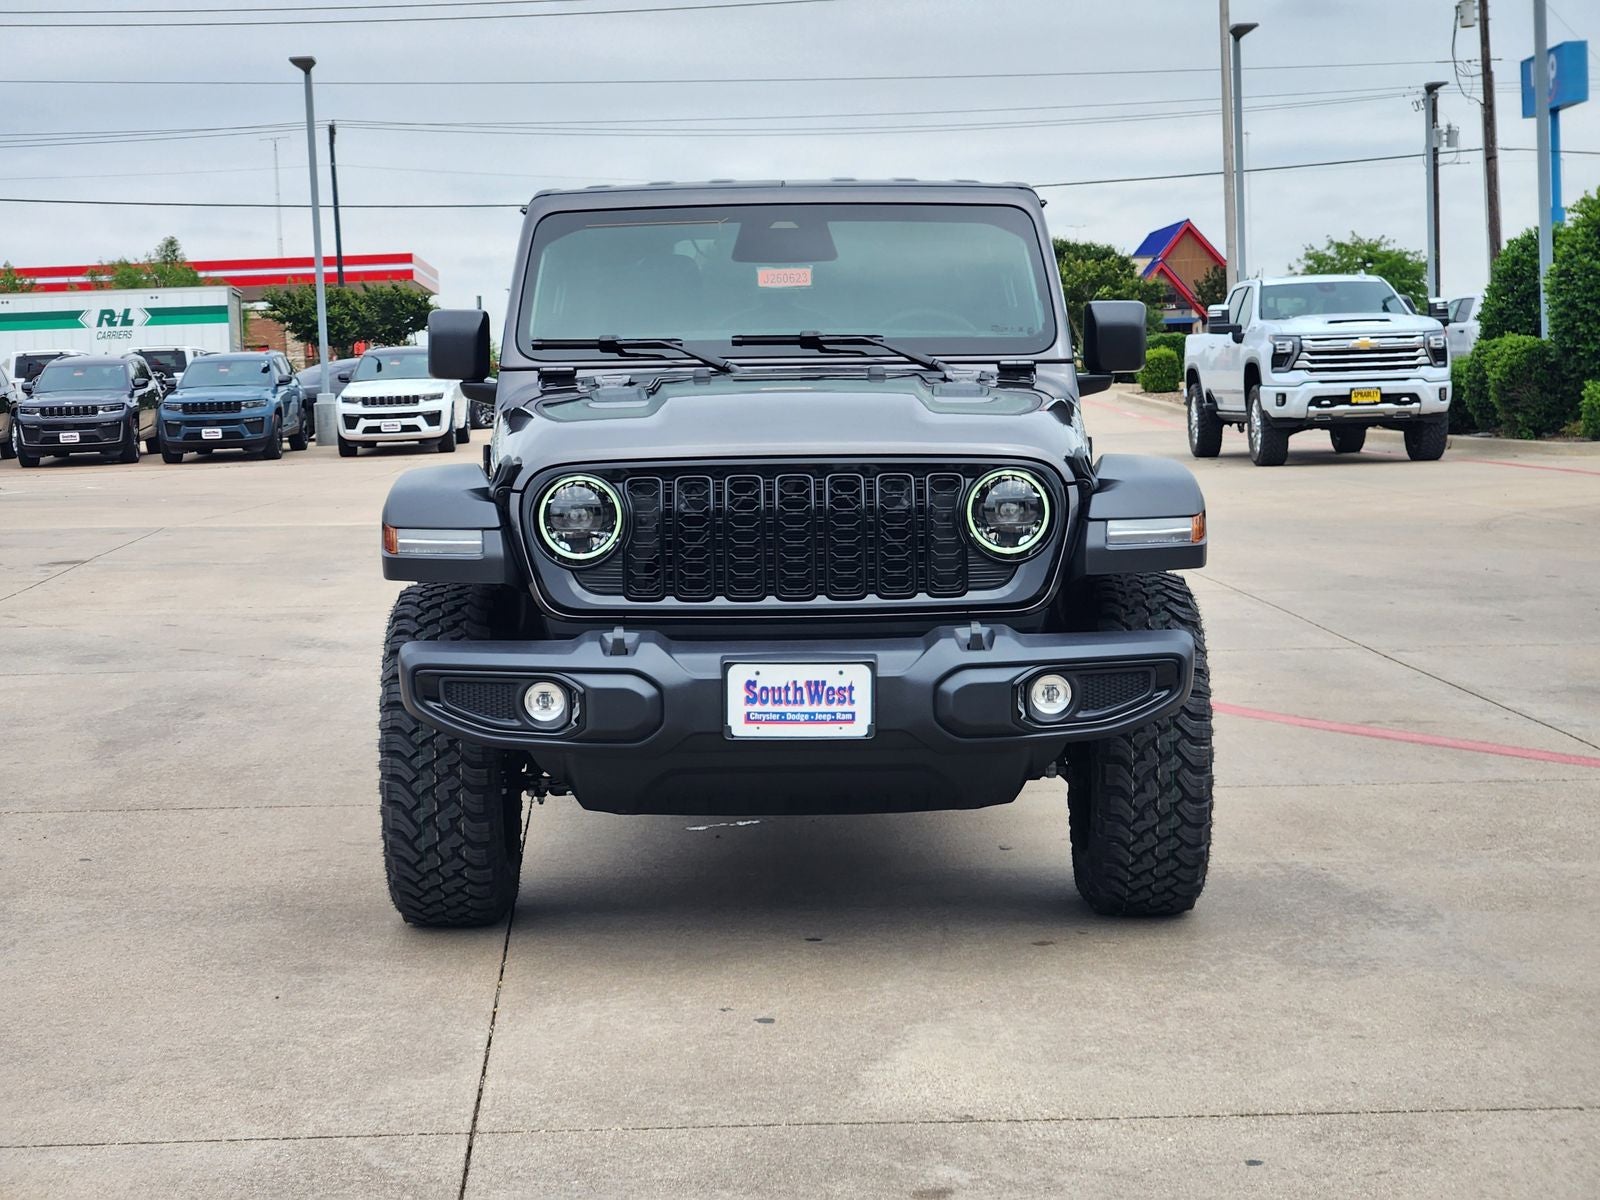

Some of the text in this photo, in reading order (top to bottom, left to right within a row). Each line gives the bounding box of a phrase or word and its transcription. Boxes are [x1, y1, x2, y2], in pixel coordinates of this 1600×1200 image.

[96, 330, 133, 340] CARRIERS
[744, 679, 856, 706] SouthWest
[750, 712, 853, 722] Chrysler Dodge Jeep Ram
